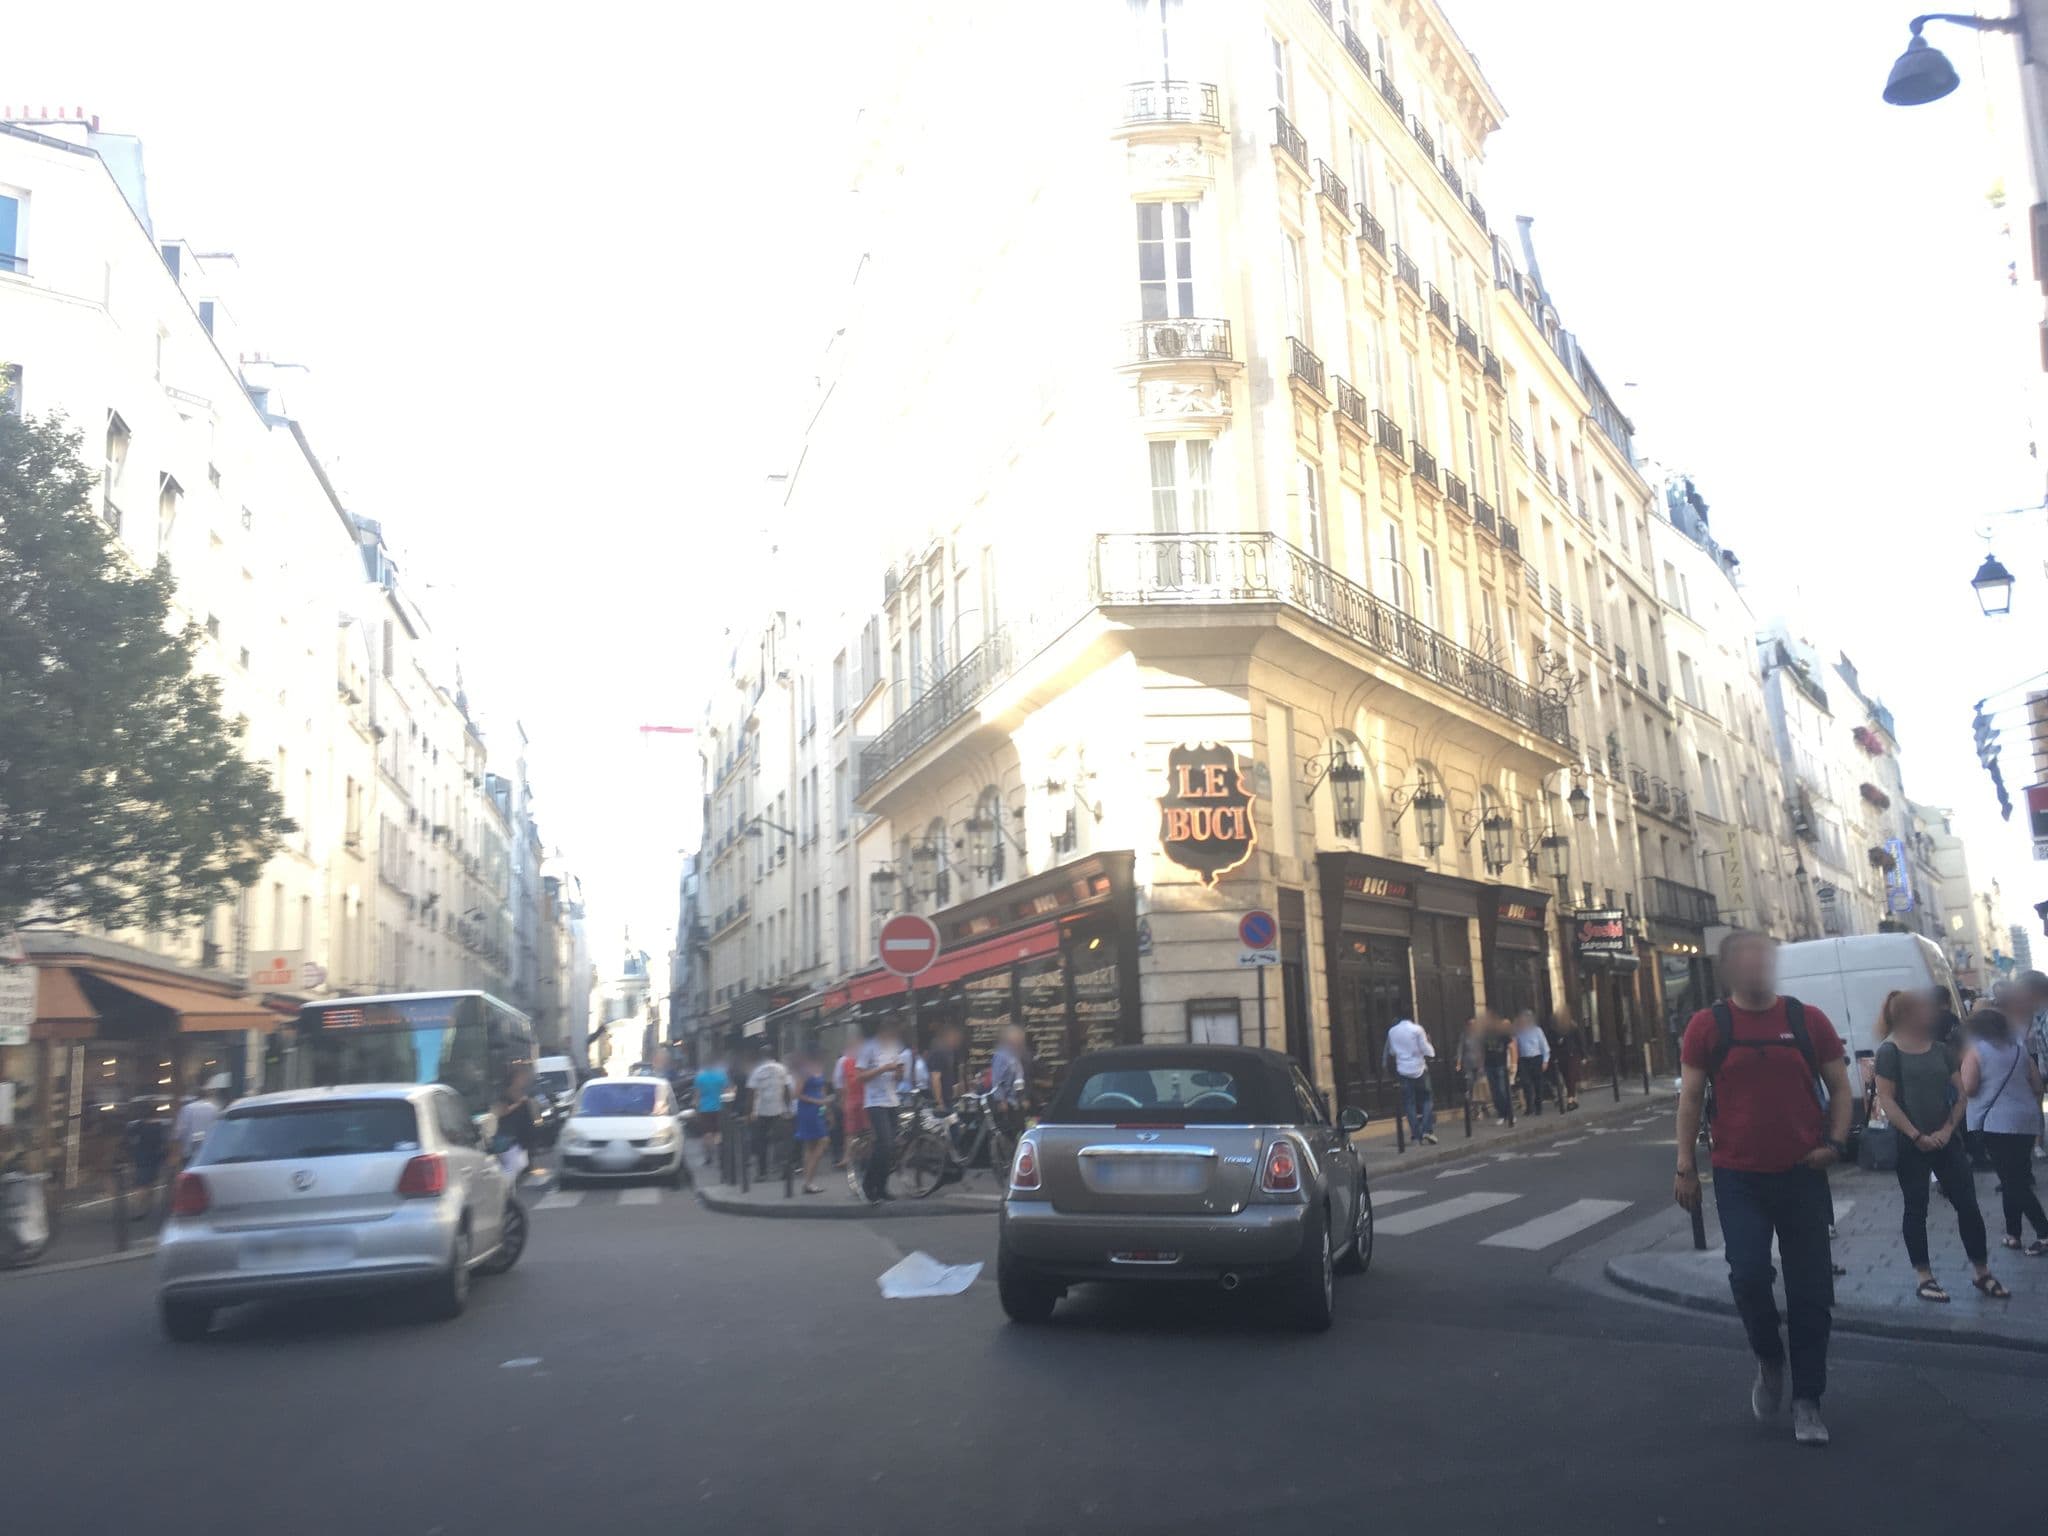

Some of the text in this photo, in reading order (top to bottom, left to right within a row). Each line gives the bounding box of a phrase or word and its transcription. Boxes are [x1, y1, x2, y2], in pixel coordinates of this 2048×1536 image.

[1176, 764, 1230, 798] LE
[1164, 806, 1246, 842] BUCI
[1727, 831, 1745, 904] PIZZA
[1362, 876, 1388, 896] BUCI
